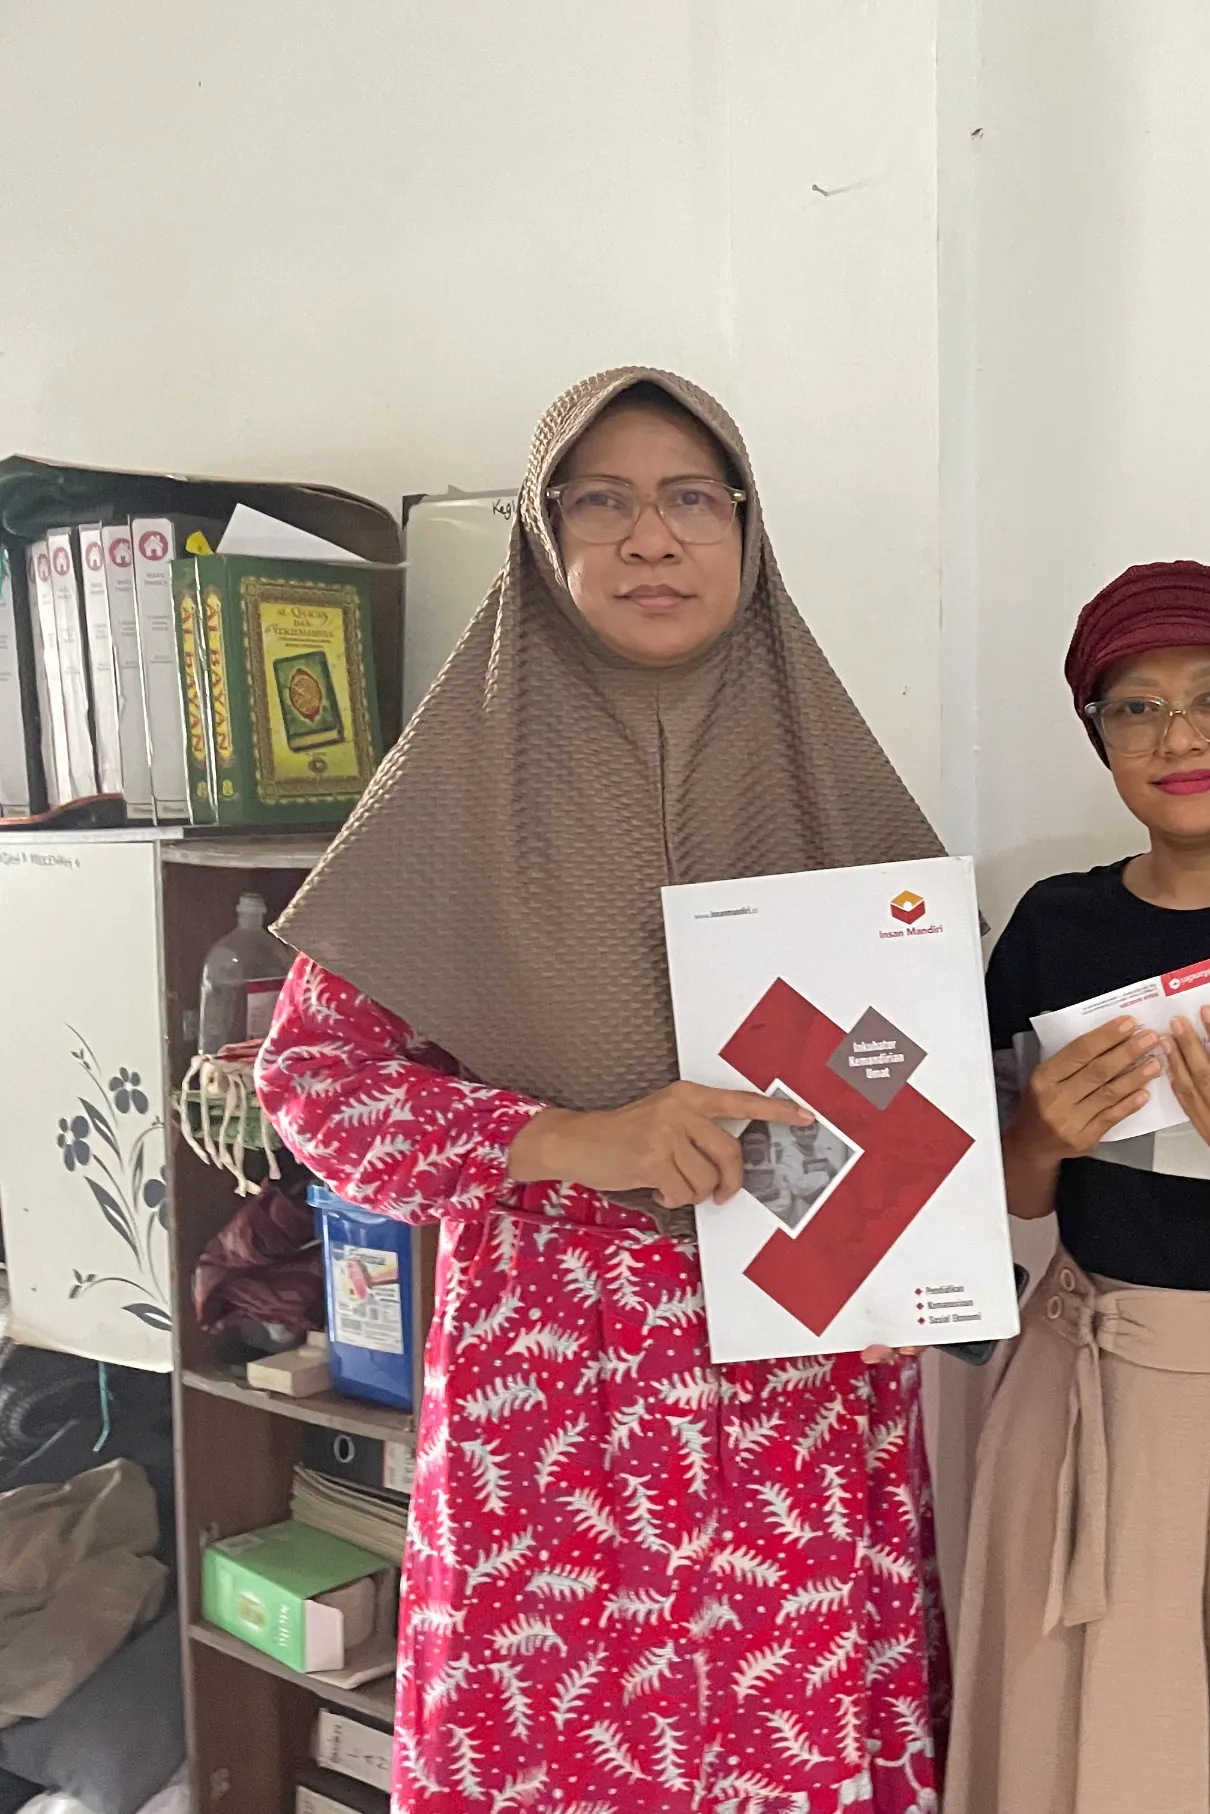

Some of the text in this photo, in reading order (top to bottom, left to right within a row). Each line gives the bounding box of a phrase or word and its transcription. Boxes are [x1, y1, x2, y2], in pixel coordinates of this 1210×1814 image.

[210, 649, 229, 750] BAYAN
[879, 924, 943, 939] Insan Mandiri
